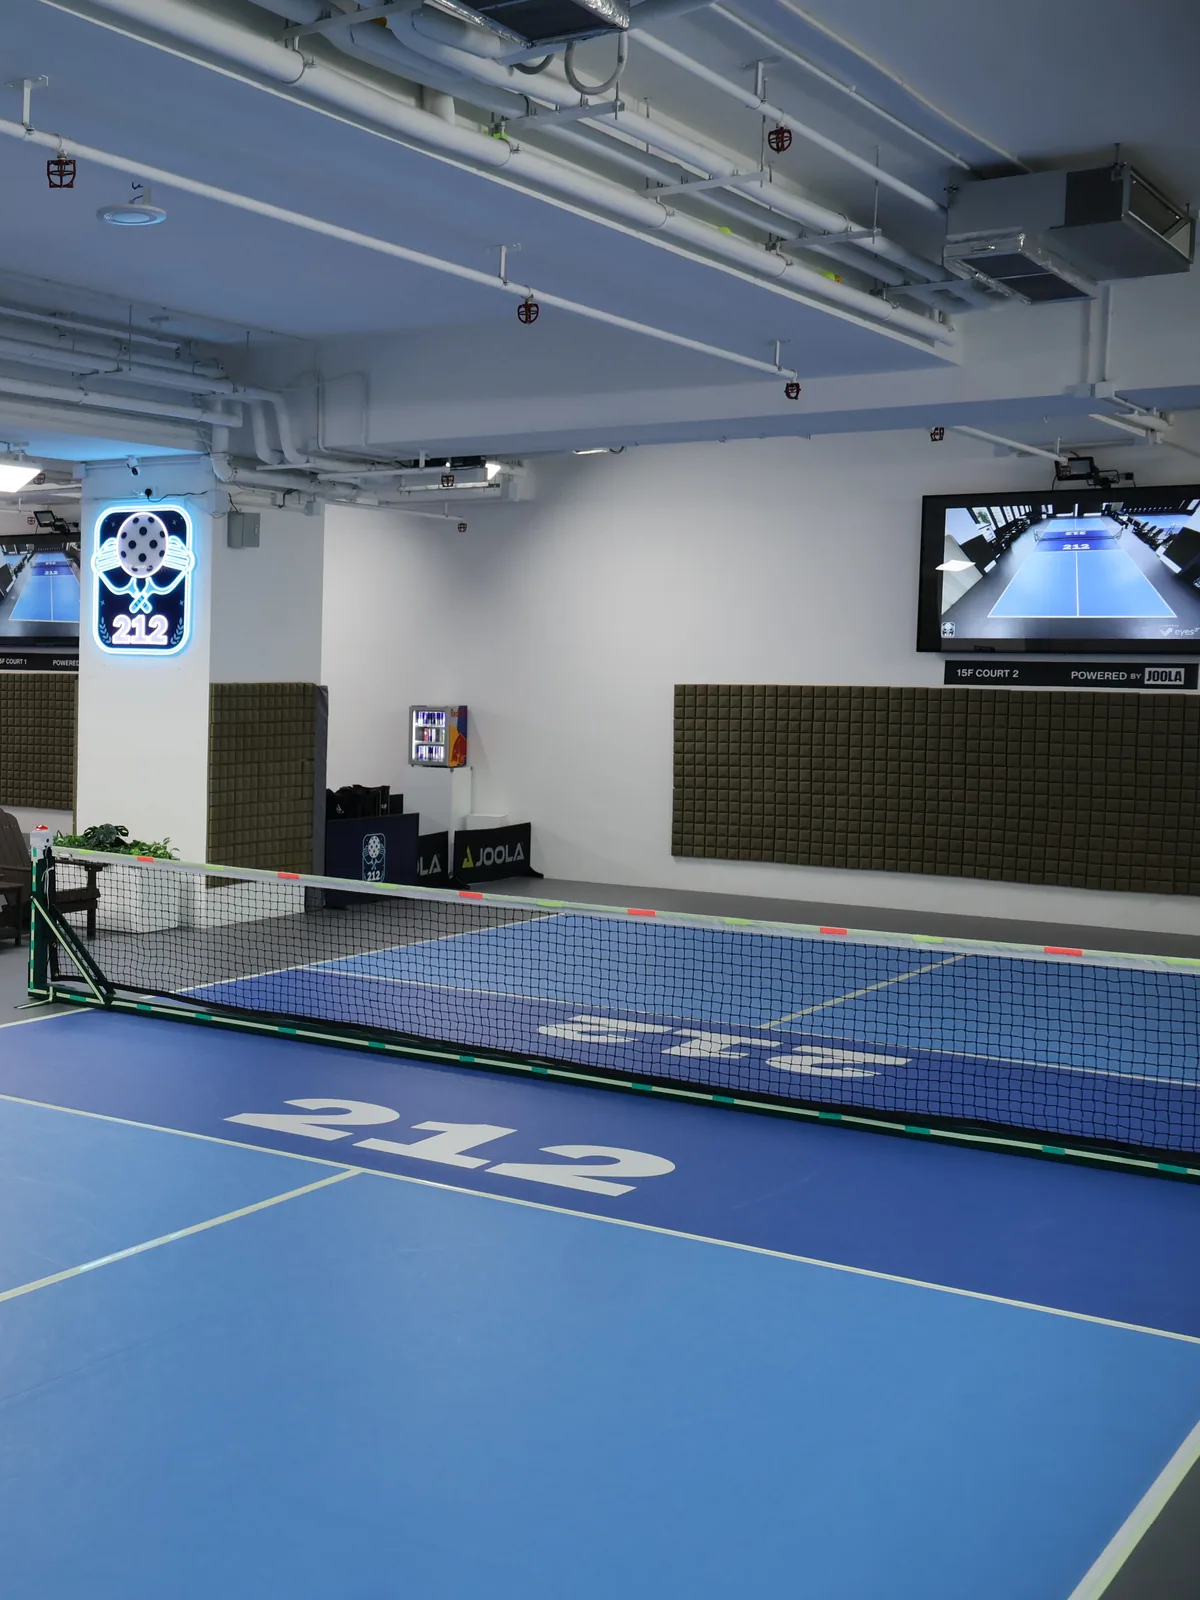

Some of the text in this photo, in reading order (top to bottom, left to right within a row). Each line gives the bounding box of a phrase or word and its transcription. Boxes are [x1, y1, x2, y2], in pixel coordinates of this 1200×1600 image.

[111, 614, 168, 646] 212
[956, 668, 974, 678] 15F
[976, 669, 1011, 679] COURT
[1012, 670, 1019, 679] 2
[1071, 670, 1128, 681] POWERED
[1145, 670, 1183, 683] JOOLA
[475, 842, 525, 868] JOOLA
[367, 870, 381, 882] 212
[222, 1098, 676, 1198] 212
